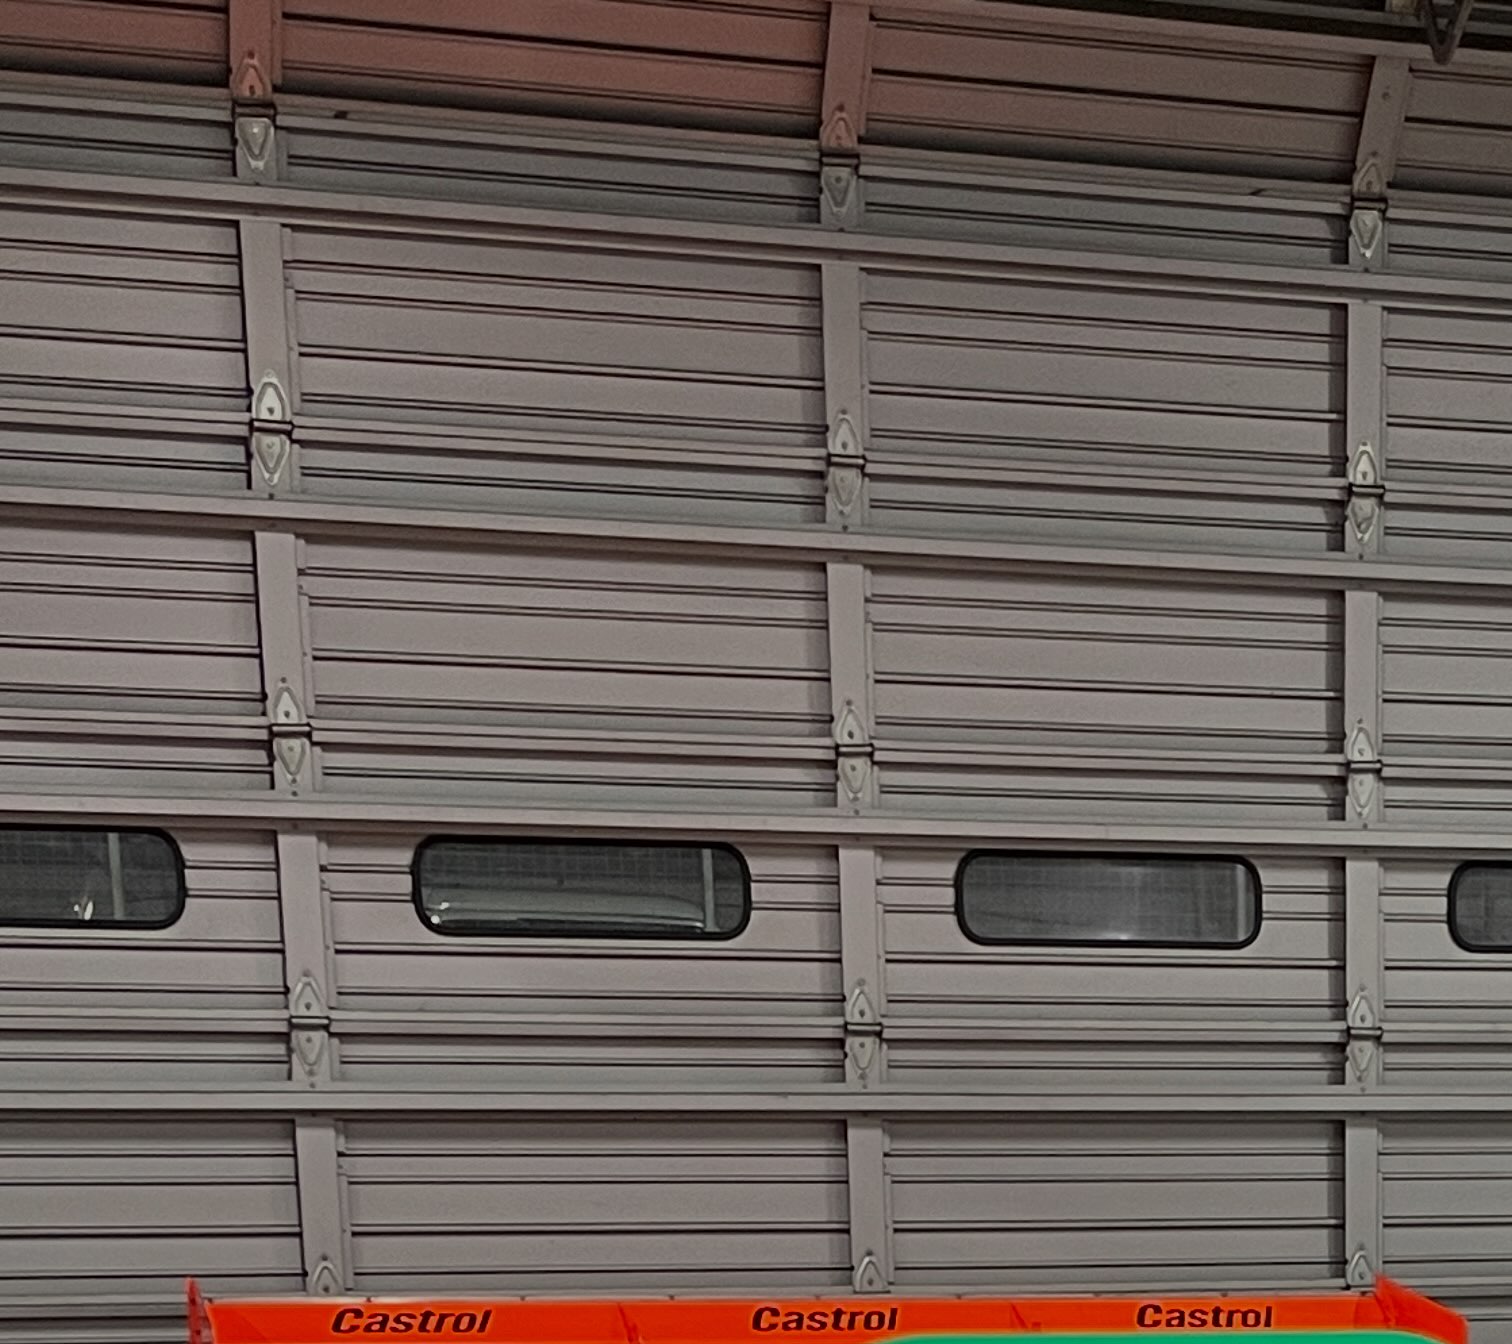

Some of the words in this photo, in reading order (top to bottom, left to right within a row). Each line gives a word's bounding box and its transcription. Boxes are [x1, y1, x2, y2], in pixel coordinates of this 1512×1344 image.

[331, 1306, 493, 1334] Castrol
[751, 1305, 899, 1333] Castrol
[1136, 1303, 1273, 1329] Castrol
